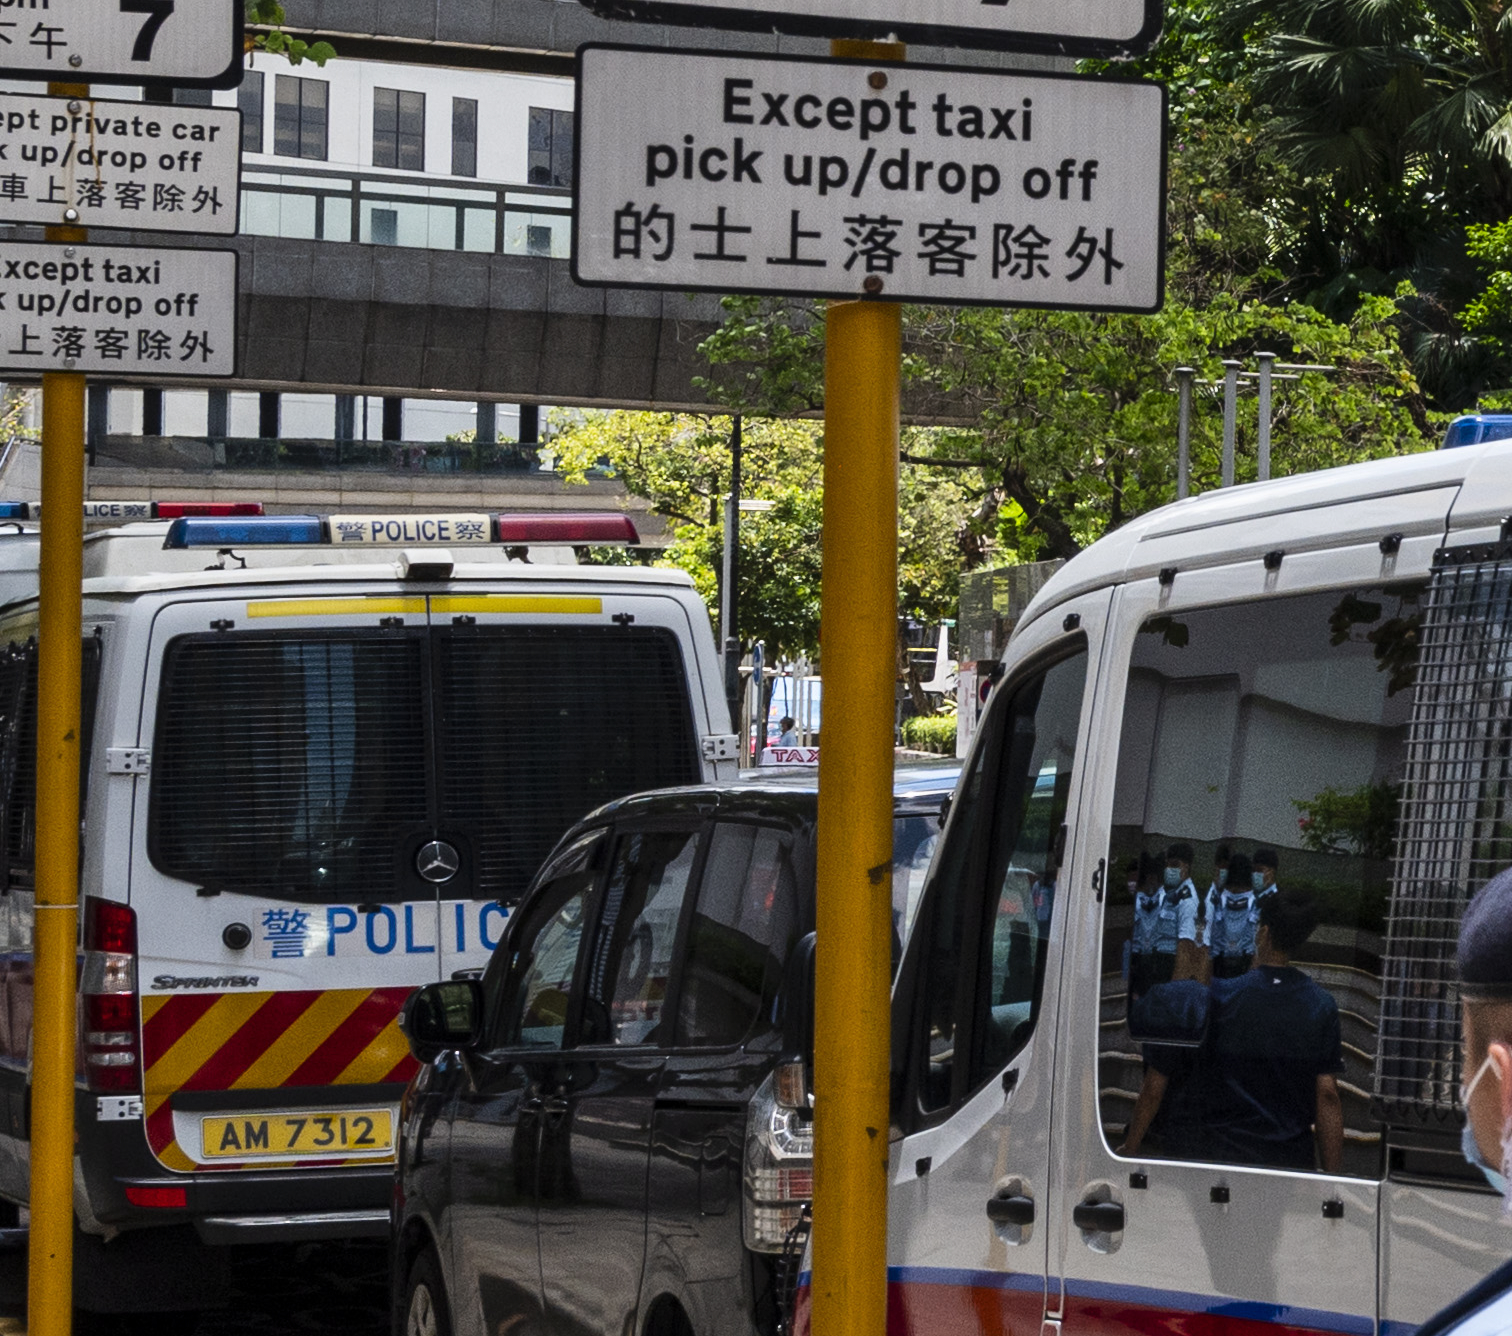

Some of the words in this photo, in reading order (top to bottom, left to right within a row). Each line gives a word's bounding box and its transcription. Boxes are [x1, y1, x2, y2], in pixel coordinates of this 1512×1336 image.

[50, 112, 162, 139] private
[172, 122, 221, 143] car
[722, 78, 919, 141] Except
[931, 88, 1034, 142] taxi
[21, 140, 147, 173] up/drop
[158, 151, 203, 172] off
[644, 134, 762, 187] pick
[783, 147, 1002, 203] up/drop
[1023, 155, 1098, 202] off
[613, 198, 1125, 287] 的士上落客除外
[0, 257, 94, 286] xcept
[102, 258, 161, 285] taxi
[18, 289, 143, 319] up/drop
[154, 293, 200, 317] off
[0, 323, 215, 363] 上落客除外
[771, 749, 820, 763] TAX
[327, 902, 509, 957] POLIC
[219, 1119, 271, 1151] AM
[285, 1115, 376, 1148] 7312
